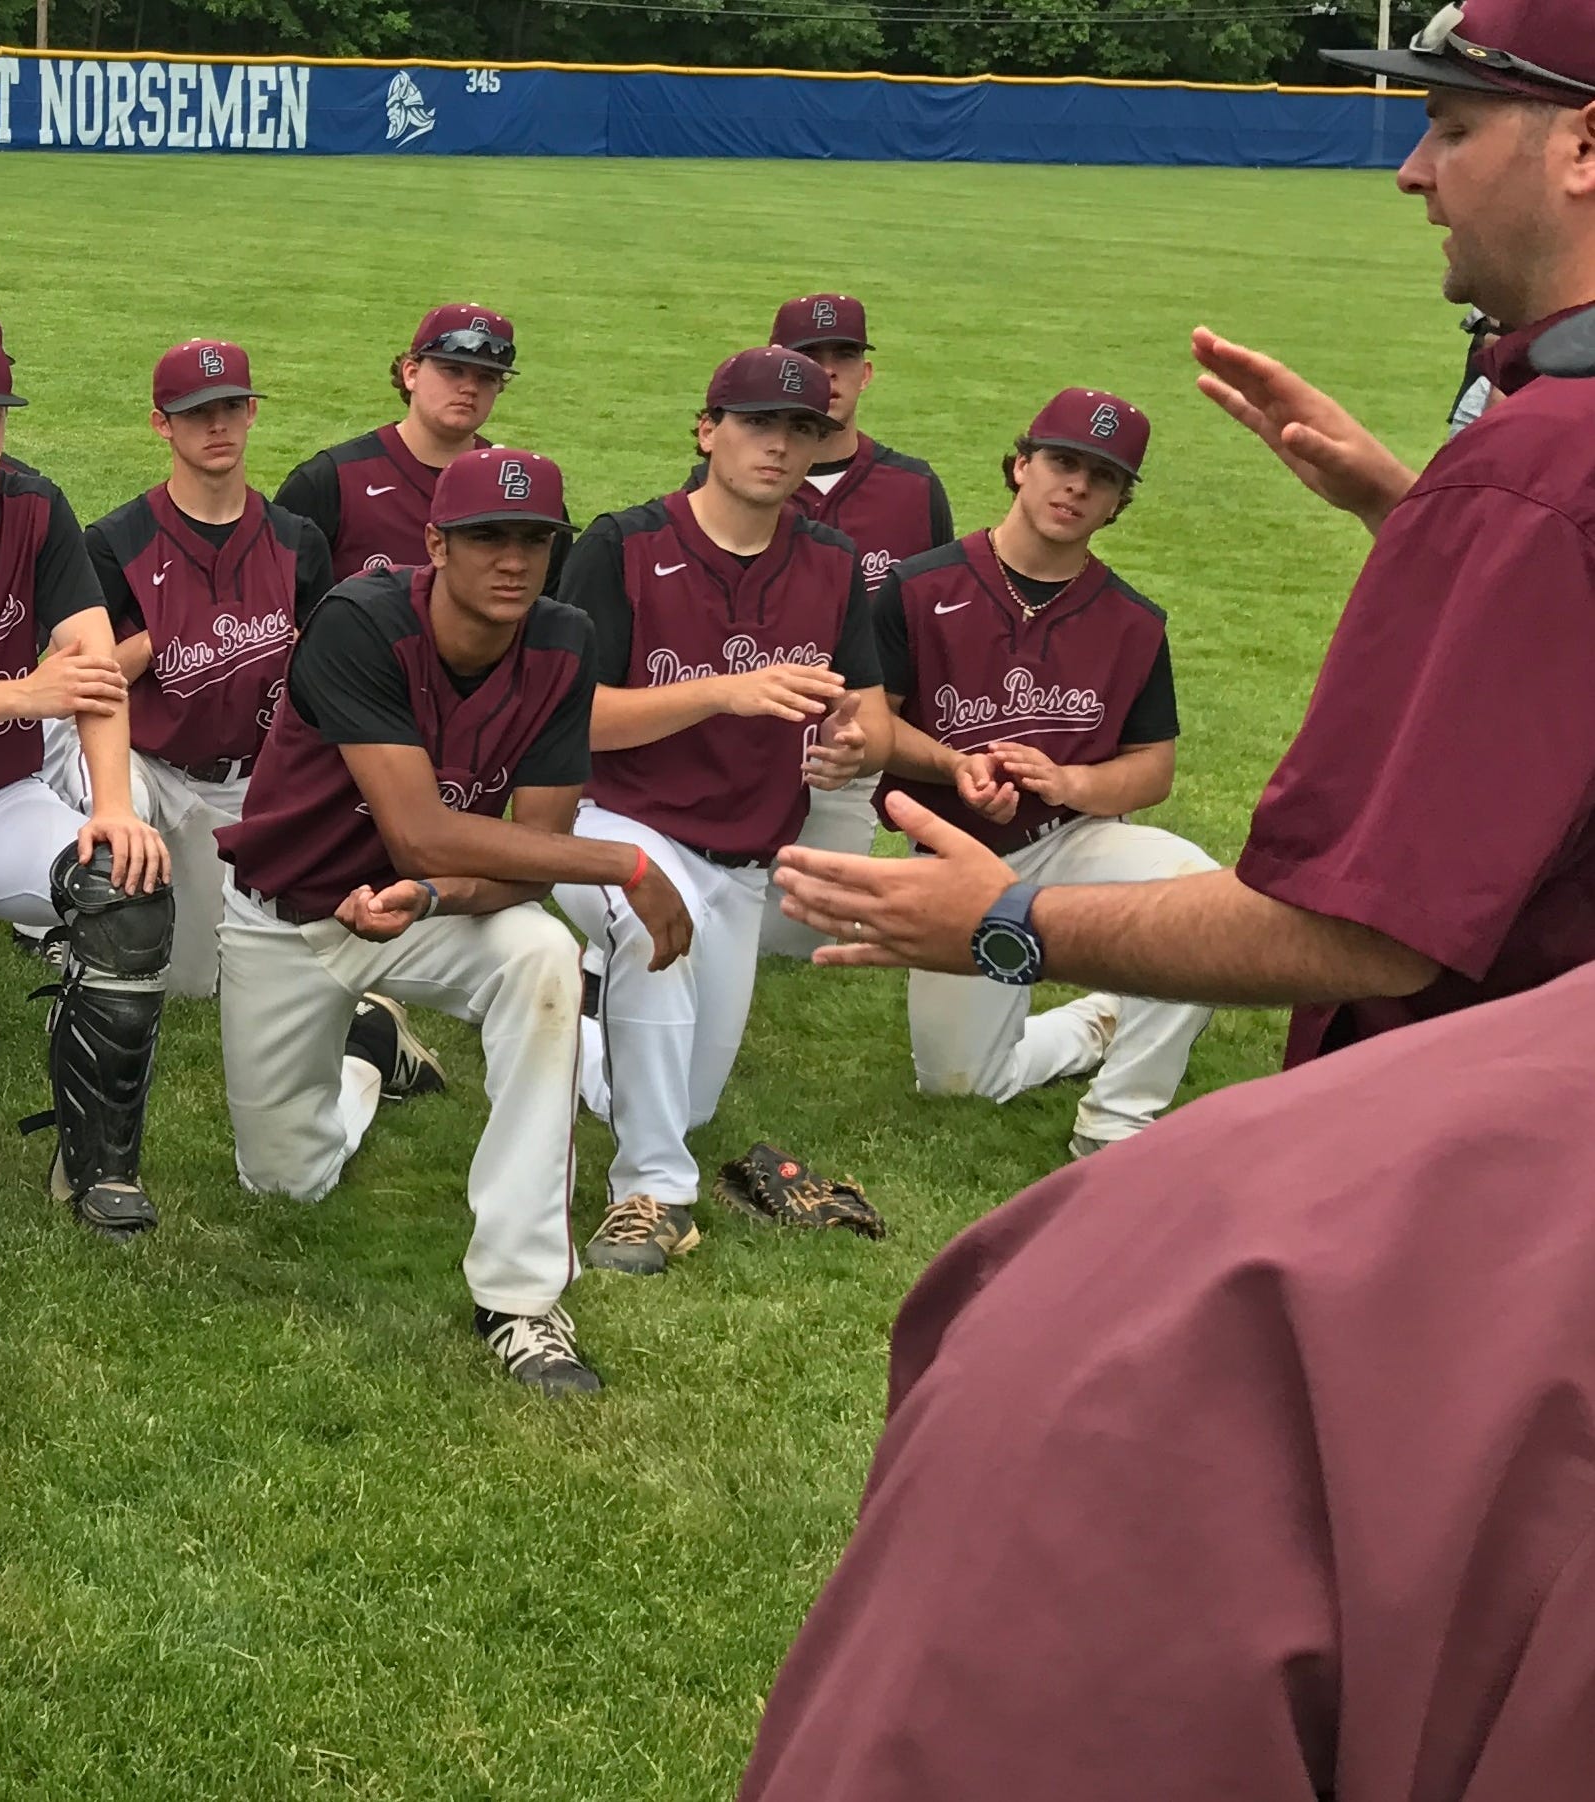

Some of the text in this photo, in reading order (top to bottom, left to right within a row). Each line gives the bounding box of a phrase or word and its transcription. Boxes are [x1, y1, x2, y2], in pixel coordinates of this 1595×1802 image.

[466, 68, 501, 93] 345
[38, 59, 310, 149] NORSEMEN
[811, 301, 837, 329] DB
[199, 346, 225, 377] DB
[1090, 403, 1119, 439] DB
[498, 460, 531, 500] DB
[155, 636, 215, 680] Don
[935, 667, 1105, 731] Don Bosco
